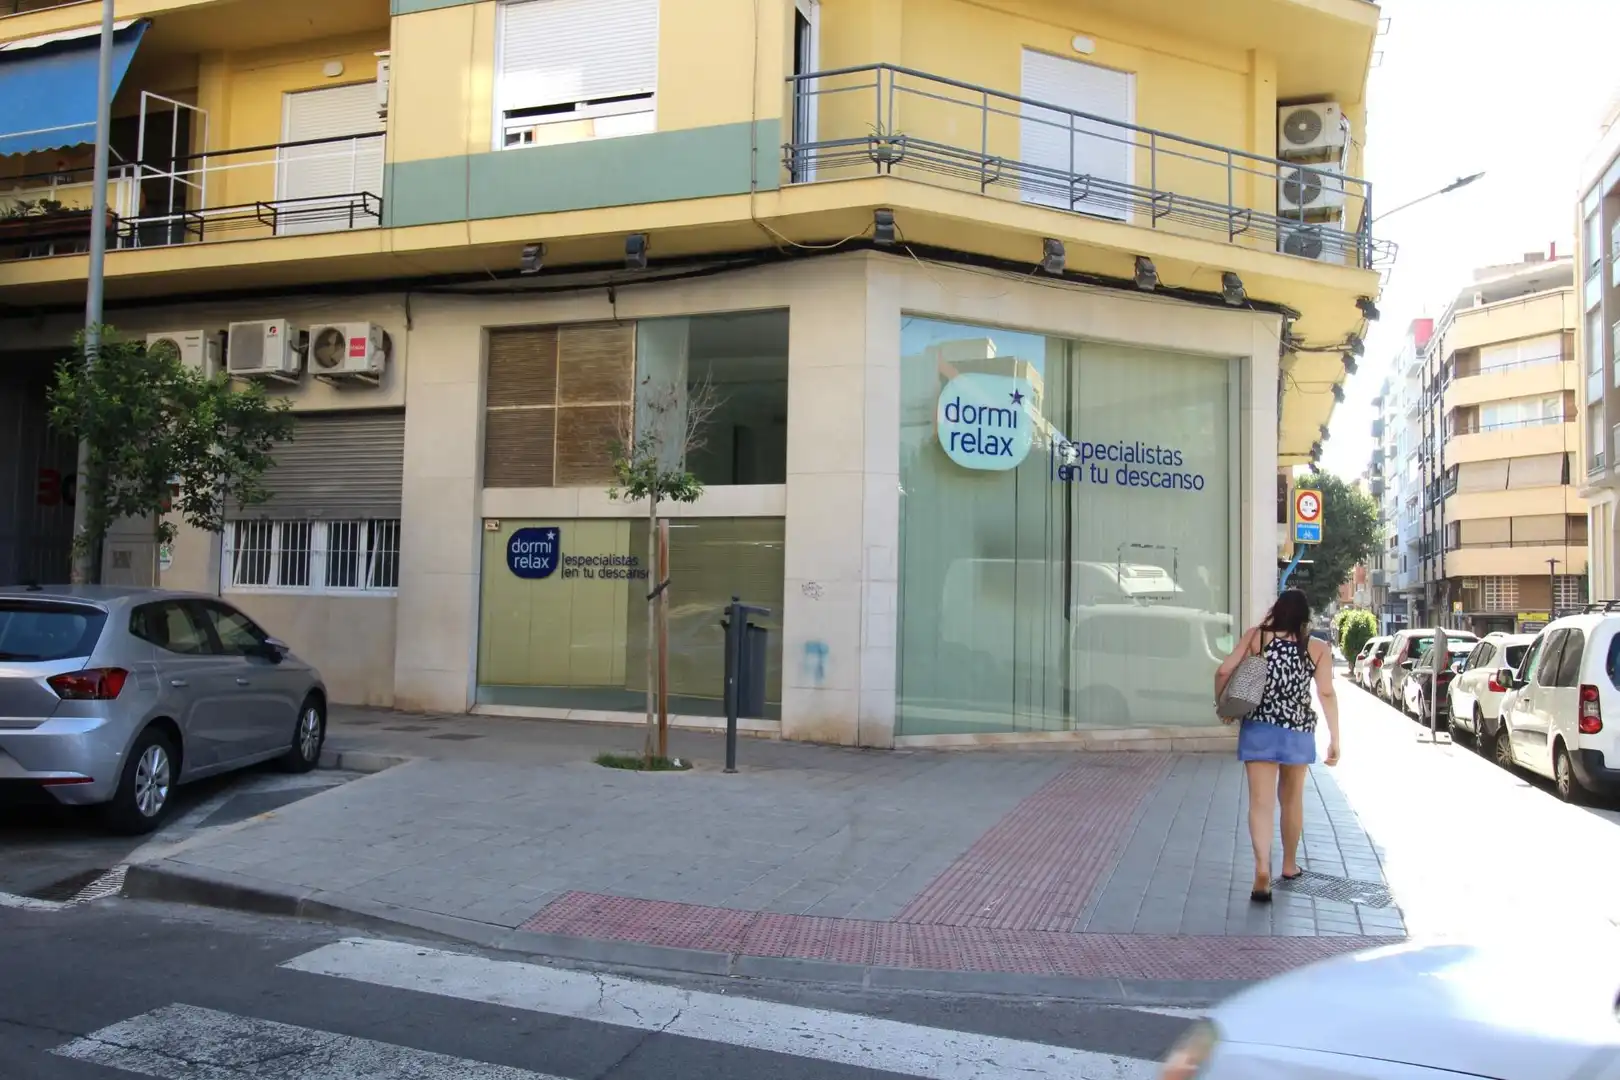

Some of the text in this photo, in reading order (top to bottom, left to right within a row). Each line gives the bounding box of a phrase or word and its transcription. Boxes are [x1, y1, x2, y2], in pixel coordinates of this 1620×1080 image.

[944, 396, 1018, 429] dormi
[950, 428, 1014, 457] relax
[1058, 440, 1184, 467] especialistas
[1057, 463, 1205, 491] en tu descanso
[511, 538, 552, 554] dormi
[514, 553, 550, 569] relax
[565, 553, 639, 568] especialistas
[564, 566, 579, 579] en
[583, 566, 595, 579] tu
